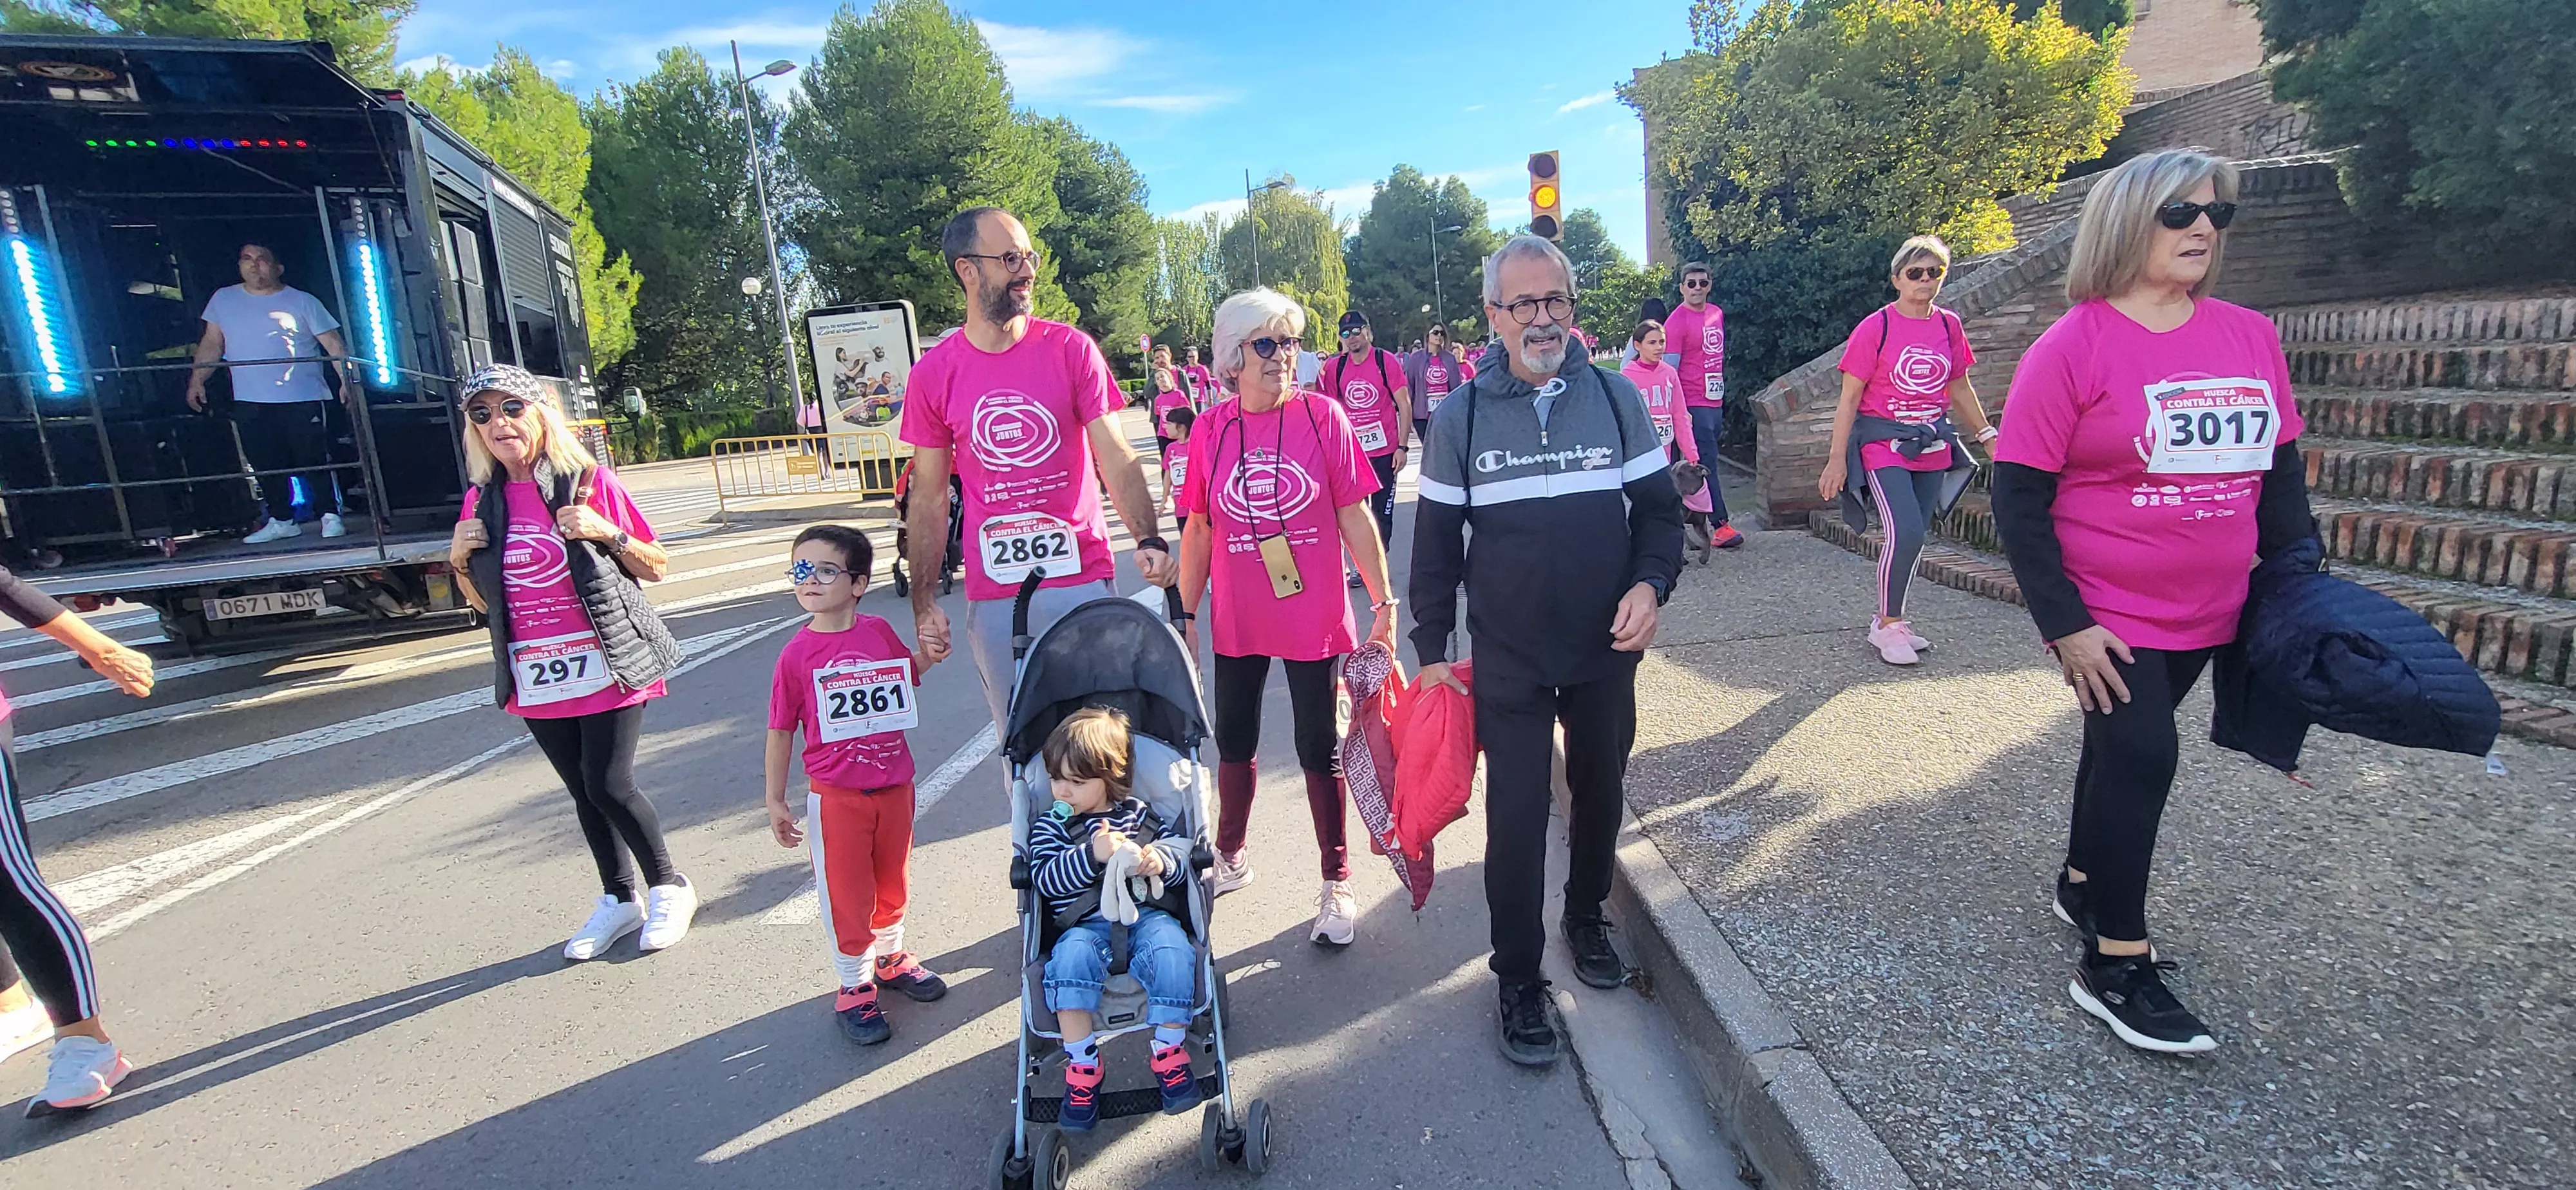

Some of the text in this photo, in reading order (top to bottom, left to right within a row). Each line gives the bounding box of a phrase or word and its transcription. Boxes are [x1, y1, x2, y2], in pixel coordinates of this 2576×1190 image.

[837, 319, 867, 328] experiencia
[2203, 388, 2237, 397] HUESCA
[2166, 394, 2266, 409] CONTRA EL CÁNCER
[996, 428, 1023, 441] JUNTOS
[2168, 410, 2269, 447] 3017
[1359, 432, 1378, 445] 728
[1475, 444, 1613, 473] Champion
[1248, 484, 1275, 495] JUNTOS
[990, 527, 1022, 537] CONTRA
[1033, 522, 1058, 531] CÁNC
[1014, 519, 1037, 527] HUESCA
[991, 532, 1069, 565] 2862
[220, 590, 320, 616] 0671 MDK
[518, 652, 550, 661] CONTRA
[561, 643, 595, 655] CÁNCER
[529, 654, 588, 686] 297
[827, 679, 862, 689] CONTRA
[873, 673, 902, 683] CÁNCER
[828, 684, 905, 720] 2861
